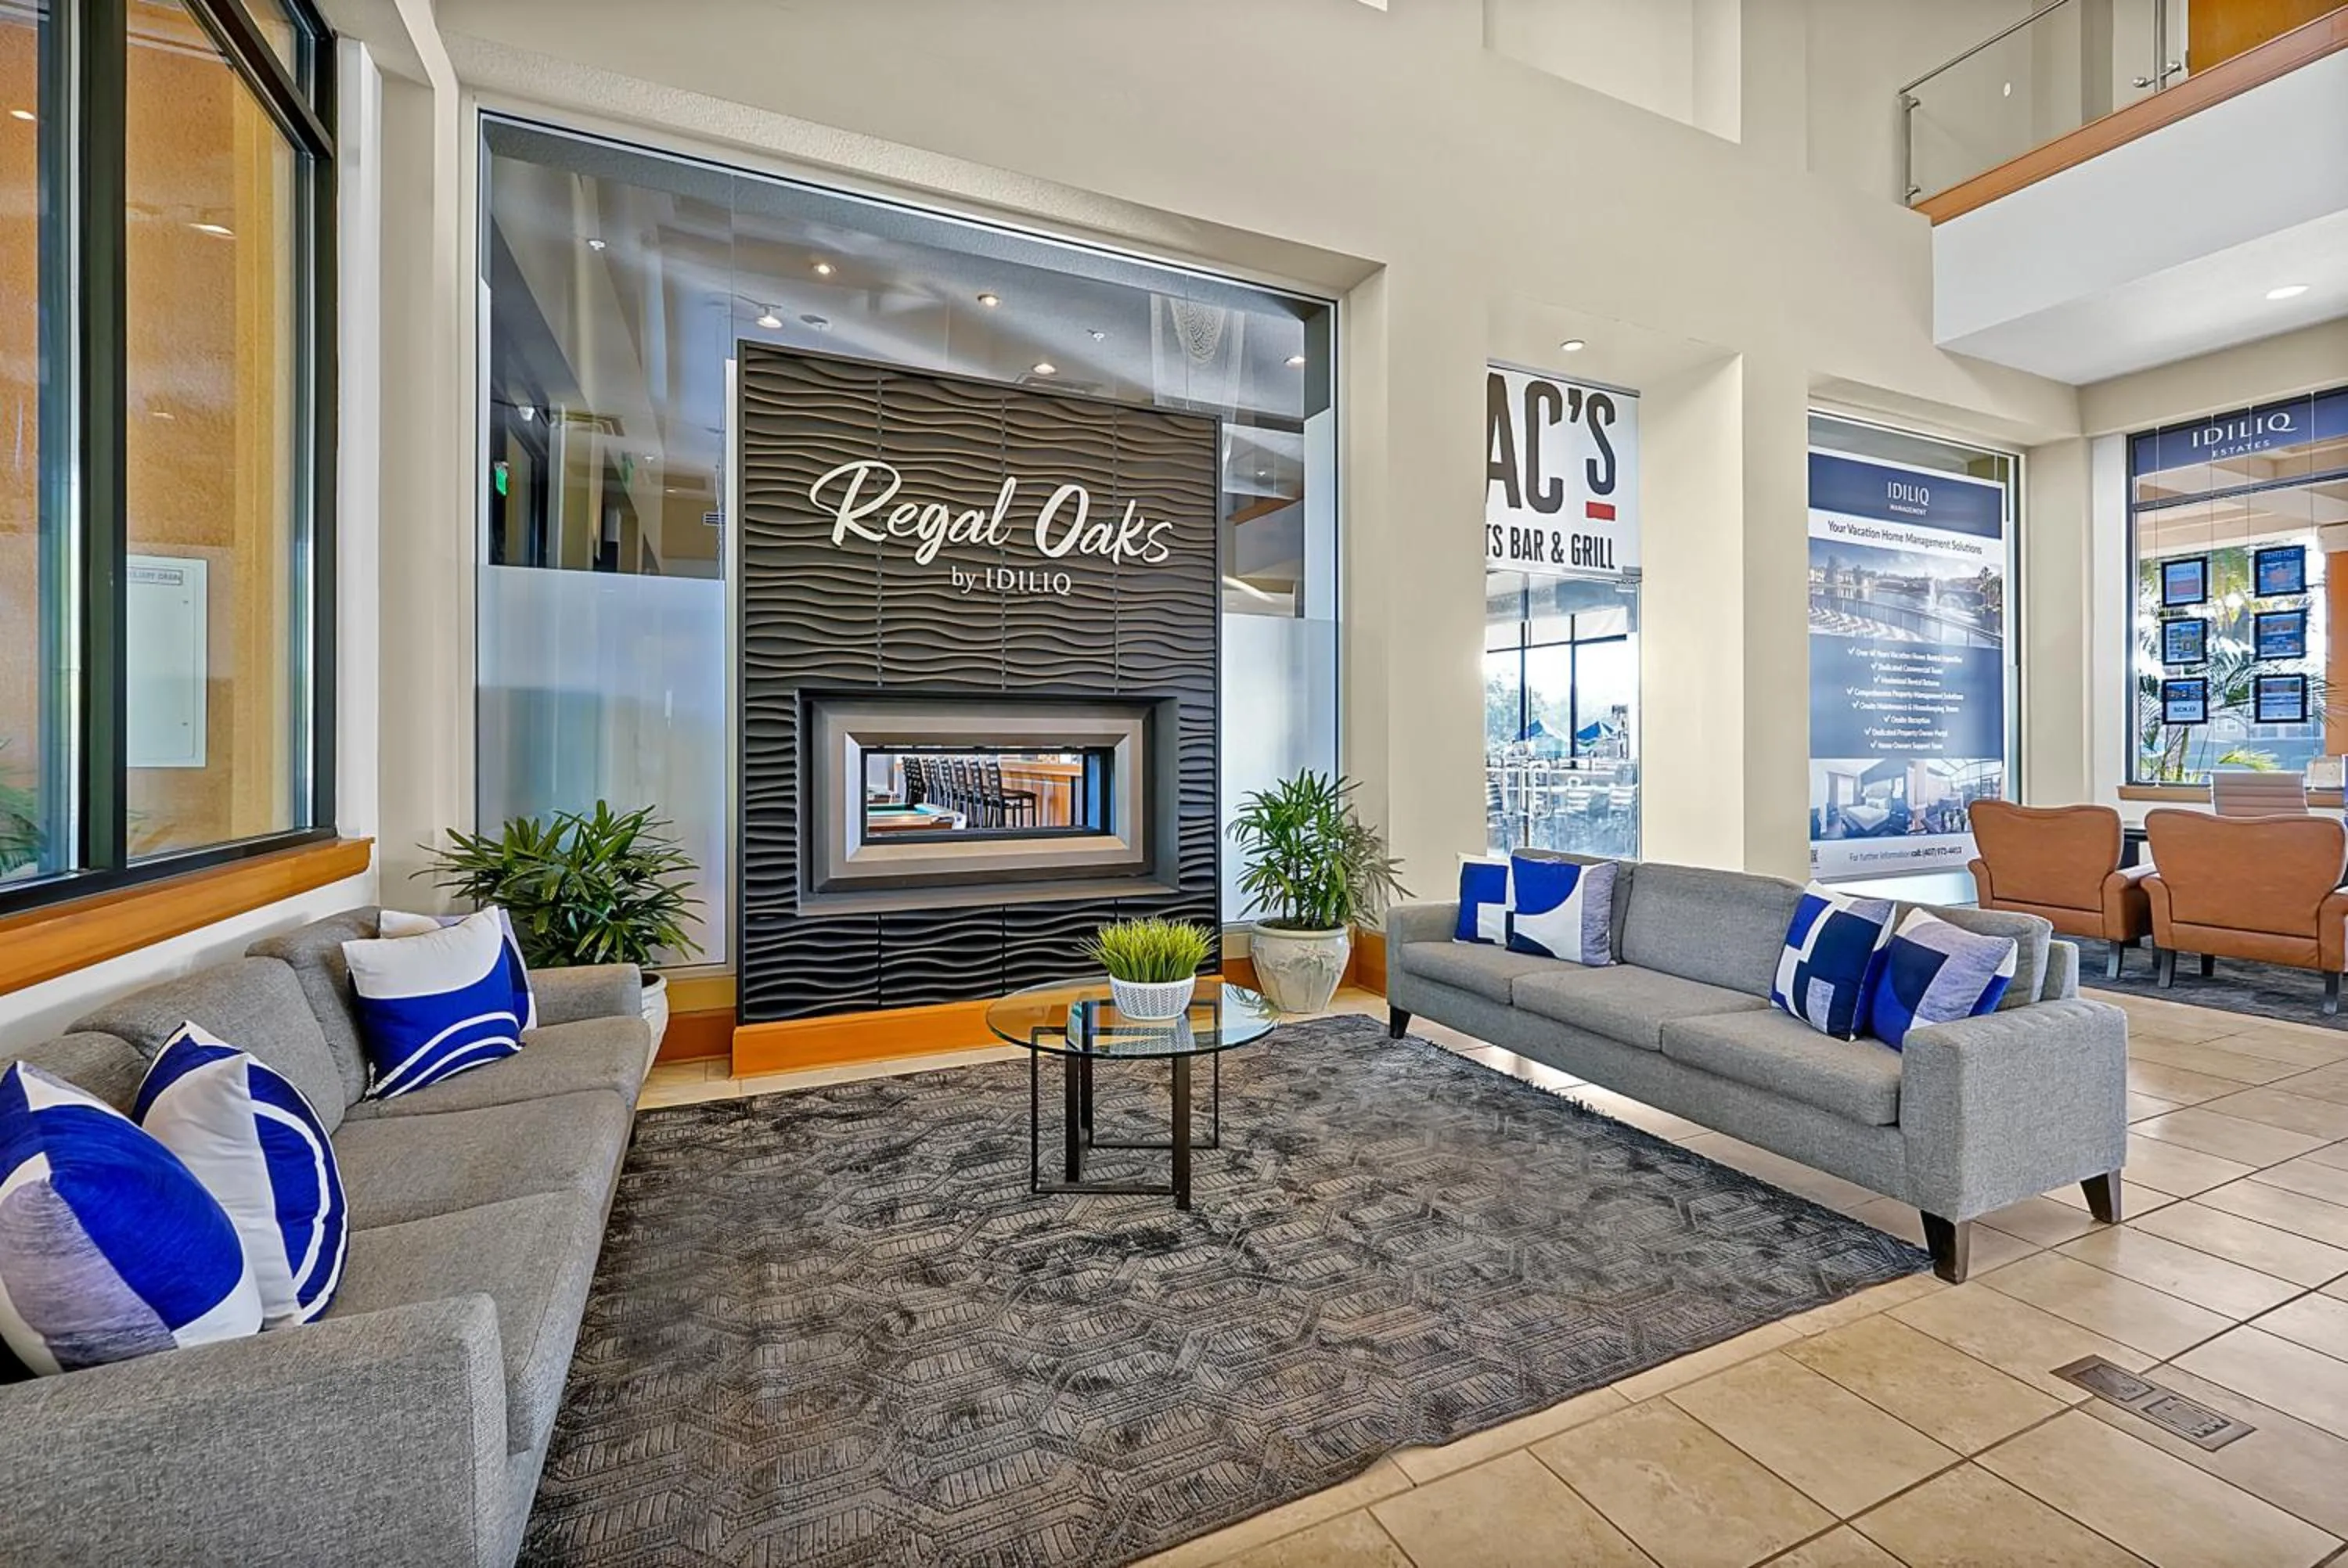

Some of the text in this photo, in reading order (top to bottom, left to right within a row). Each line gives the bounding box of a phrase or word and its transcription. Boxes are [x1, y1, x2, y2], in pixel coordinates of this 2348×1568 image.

[2192, 412, 2297, 448] IDILIQ
[2212, 439, 2271, 458] ESTATES
[1887, 481, 1929, 506] IDILIQ
[809, 460, 1173, 565] Regal Oaks
[1510, 526, 1544, 562] BAR
[1550, 531, 1565, 563] &
[1571, 533, 1615, 570] GRILL
[1828, 520, 1982, 555] Your Vacation Home Management Solutions
[951, 566, 1071, 595] by IDILIQ
